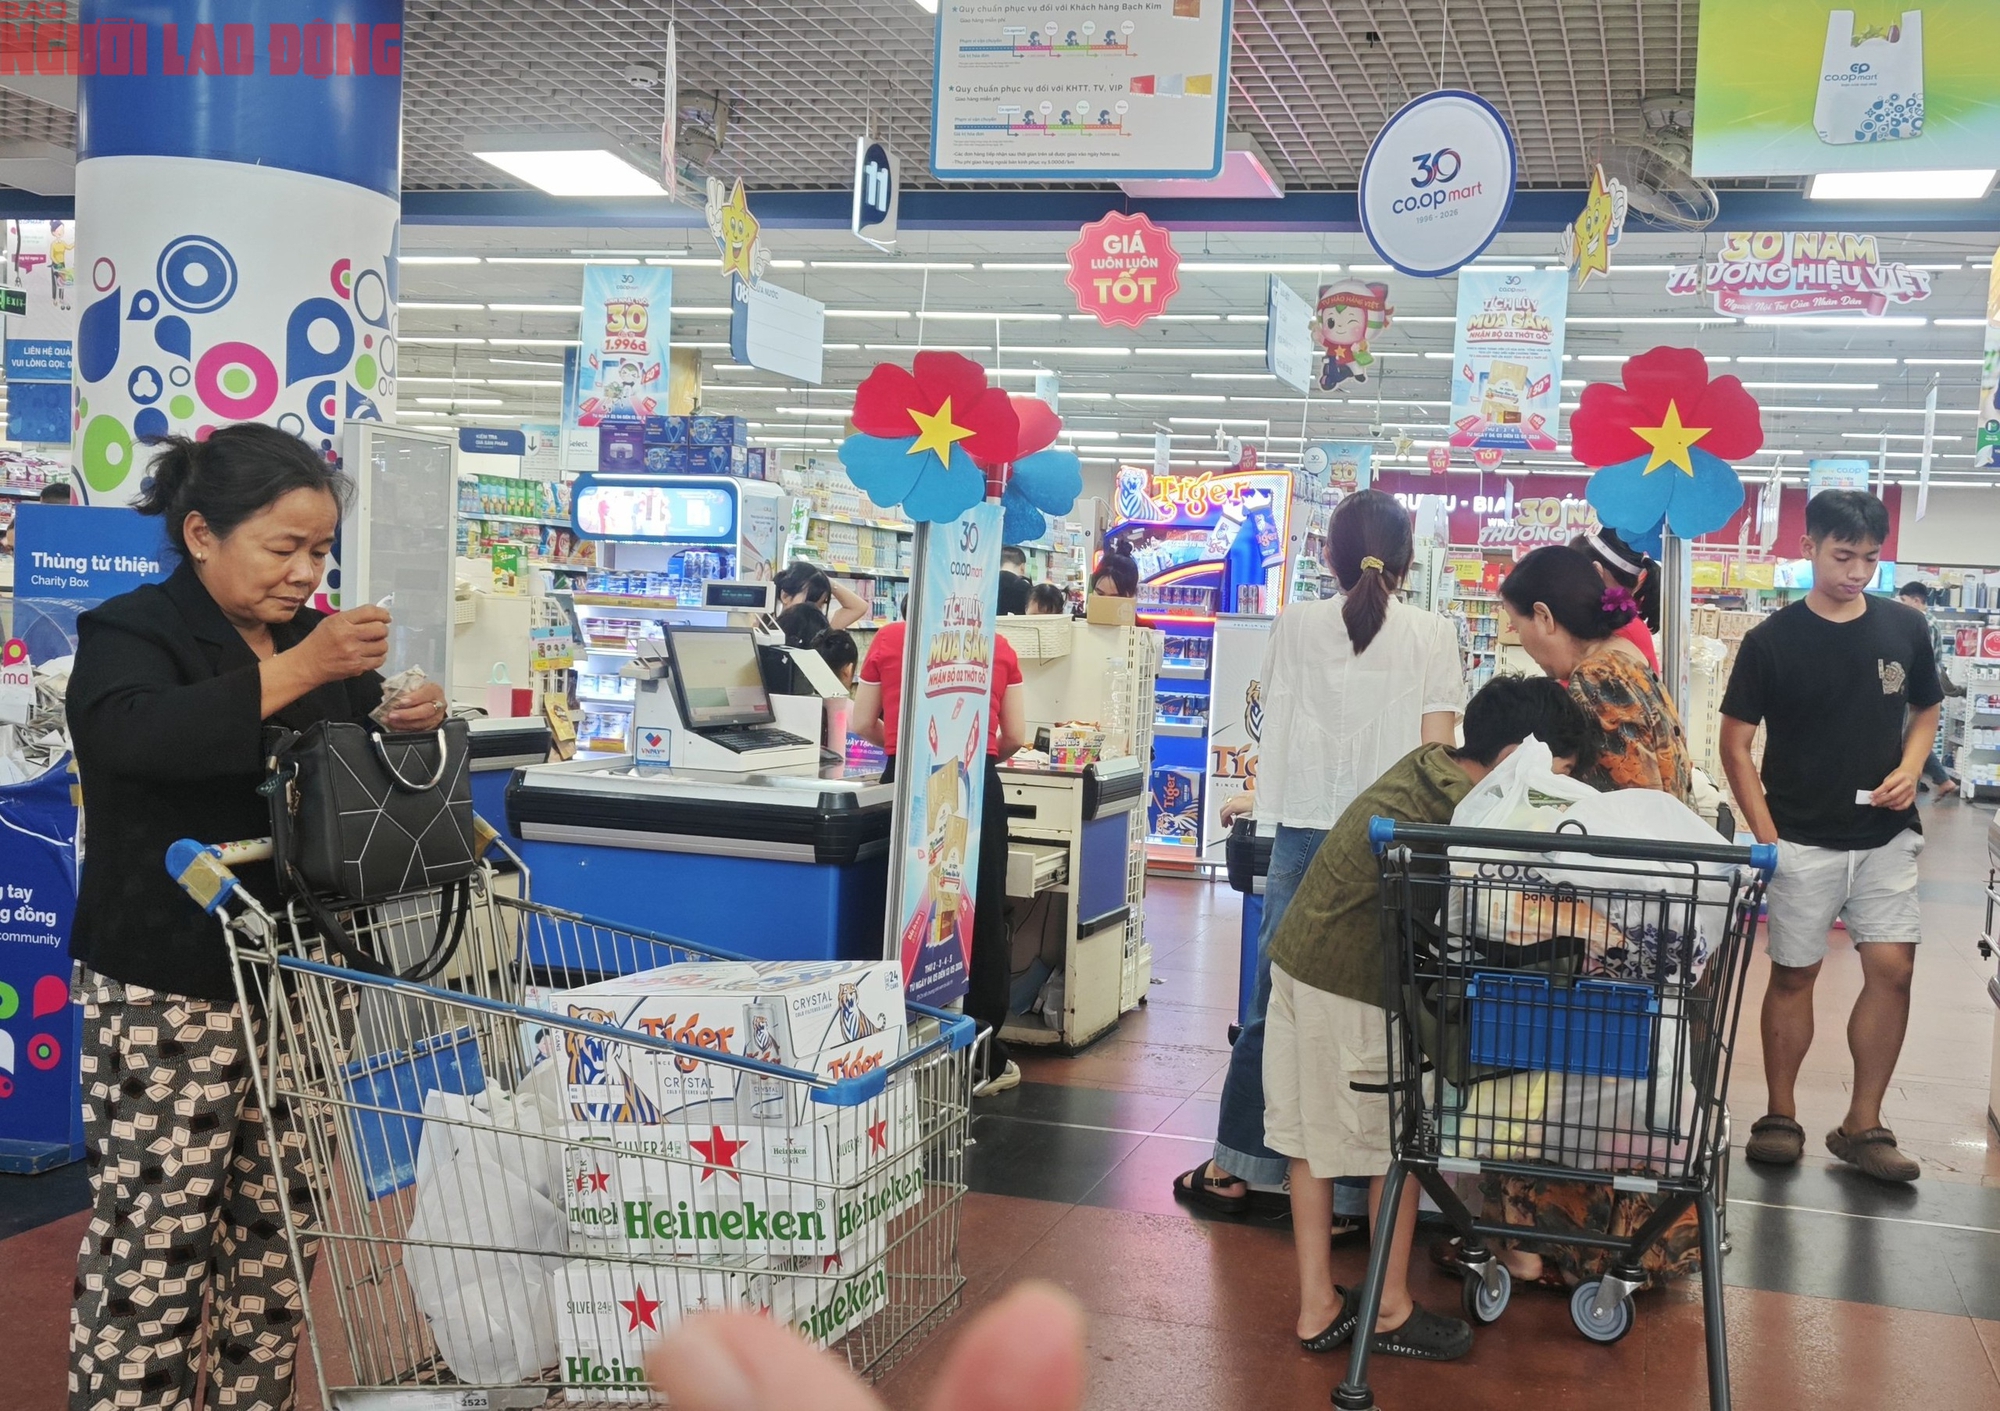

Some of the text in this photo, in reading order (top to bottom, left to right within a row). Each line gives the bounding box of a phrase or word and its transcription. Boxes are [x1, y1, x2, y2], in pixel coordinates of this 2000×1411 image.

[959, 6, 974, 14] Quy
[978, 4, 1002, 12] chuẩn
[1004, 5, 1024, 14] phục
[1070, 3, 1096, 11] Khách
[1098, 4, 1119, 12] hàng
[1122, 3, 1144, 11] Bạch
[956, 86, 971, 94] Quy
[974, 84, 998, 92] chuẩn
[1001, 86, 1021, 94] phục
[1109, 84, 1123, 92] VIP
[1410, 148, 1462, 188] 30
[1416, 209, 1458, 224] 1996 2026
[1103, 230, 1146, 254] GIÁ
[1722, 232, 1783, 261] 30
[1091, 256, 1158, 269] LUÔN LUÔN
[622, 275, 634, 283] 30
[1093, 268, 1157, 304] TỐT
[1505, 276, 1522, 285] 30
[1670, 259, 1929, 297] THƯƠNG HIỆU VIỆT
[6, 296, 23, 308] EXIT
[606, 304, 648, 332] 30
[1468, 310, 1552, 331] MUA SẮM
[1469, 332, 1490, 340] NHẬN
[1492, 331, 1503, 340] BỘ
[24, 345, 72, 357] LIÊN HỆ QUẢ
[605, 340, 646, 351] 1.996đ
[12, 357, 65, 369] VUI LÒNG GỌI:
[1432, 457, 1446, 467] TỐT
[1480, 448, 1498, 459] TỐT
[1330, 464, 1357, 481] 30
[1153, 472, 1250, 516] Tiger
[1473, 496, 1506, 512] BIA
[1517, 498, 1560, 526] 30
[960, 520, 979, 554] 30
[1480, 526, 1565, 544] THƯƠNG
[31, 552, 159, 576] Thùng từ thiện
[31, 575, 89, 588] Charity Box
[944, 592, 984, 627] TÍCH LŨY
[928, 623, 989, 667] MUA SẮM
[928, 668, 986, 689] NHẬN BỘ 02 THỚT GỖ
[1164, 772, 1178, 807] Tiger
[7, 884, 33, 903] tay
[14, 905, 56, 927] đồng
[889, 970, 898, 982] 24
[793, 990, 832, 1010] CRYSTAL
[638, 1013, 734, 1073] Tiger
[664, 1077, 714, 1088] CRYSTAL
[617, 1141, 658, 1158] SILVER
[624, 1200, 826, 1241] Heineken
[597, 1302, 607, 1310] 24
[1387, 1343, 1422, 1355] LOVELY
